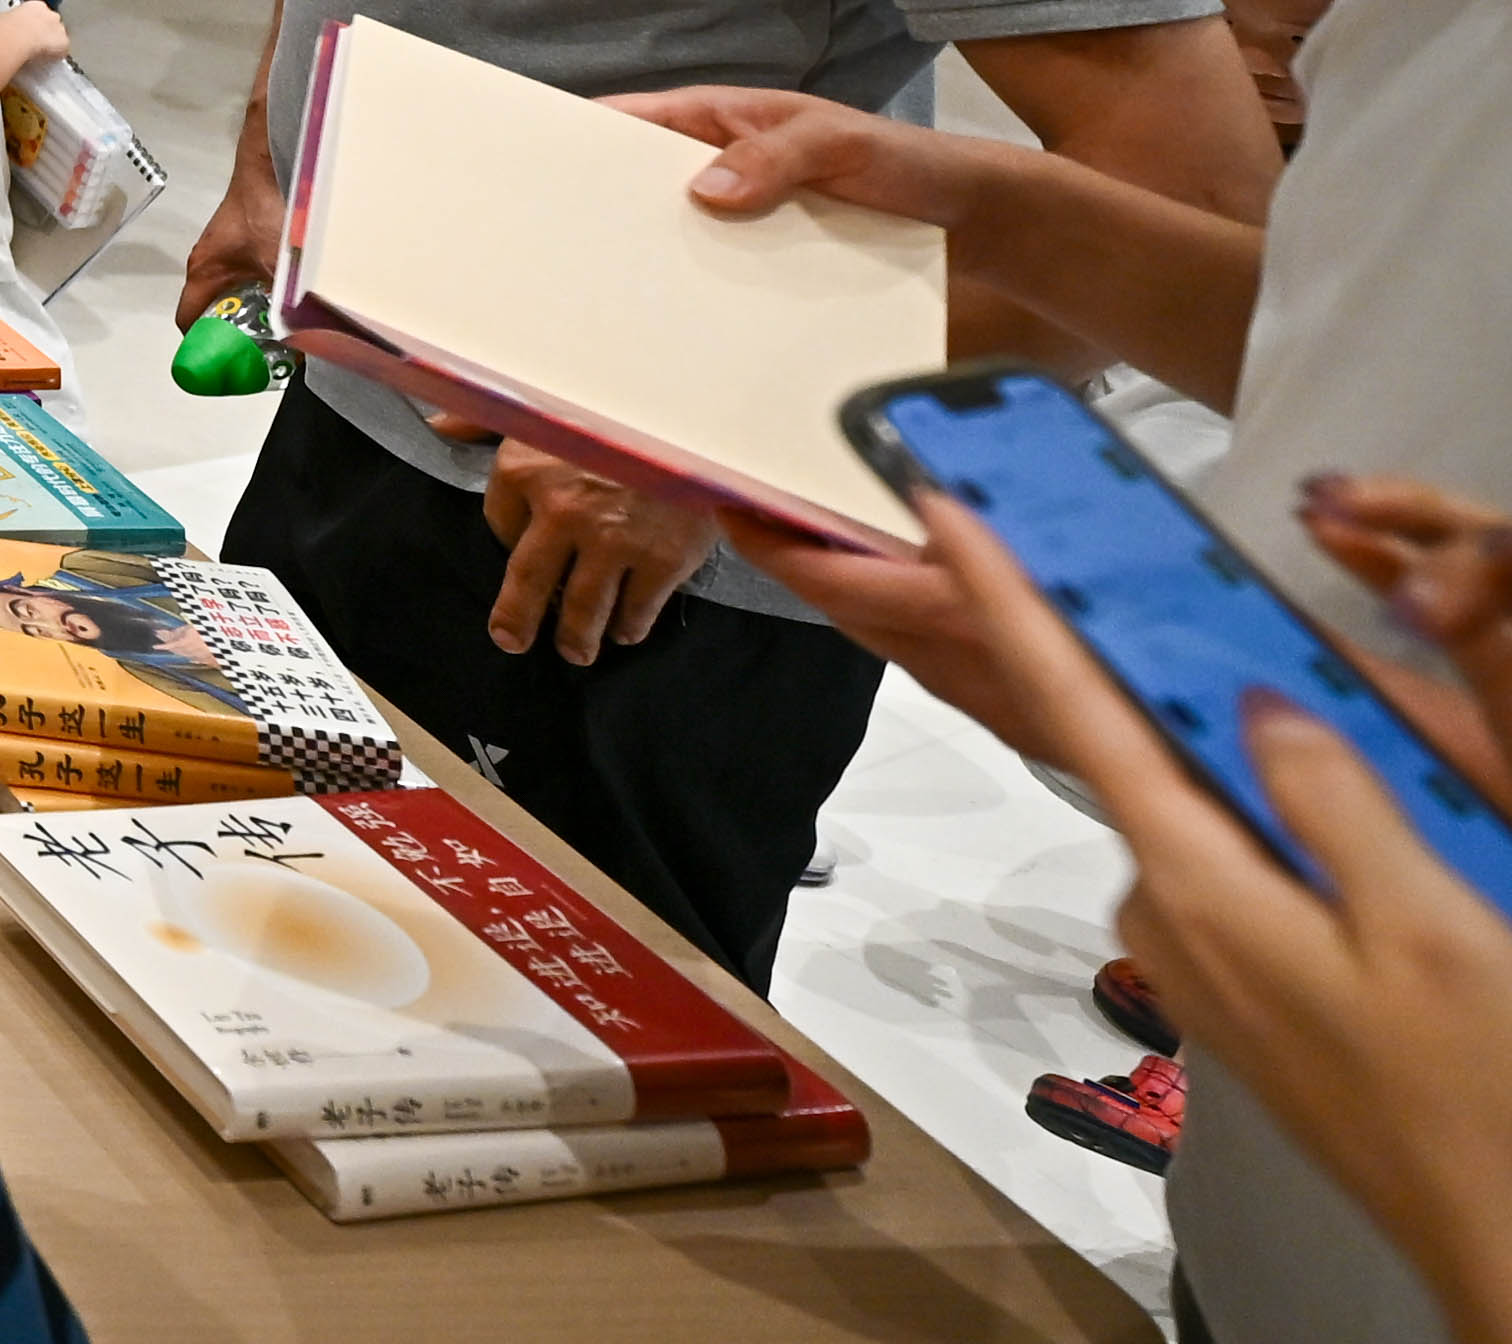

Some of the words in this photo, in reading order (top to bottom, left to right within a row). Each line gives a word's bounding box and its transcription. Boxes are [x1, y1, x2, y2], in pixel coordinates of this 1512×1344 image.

[19, 750, 183, 796] 孔子这一生
[23, 814, 326, 882] 老子传
